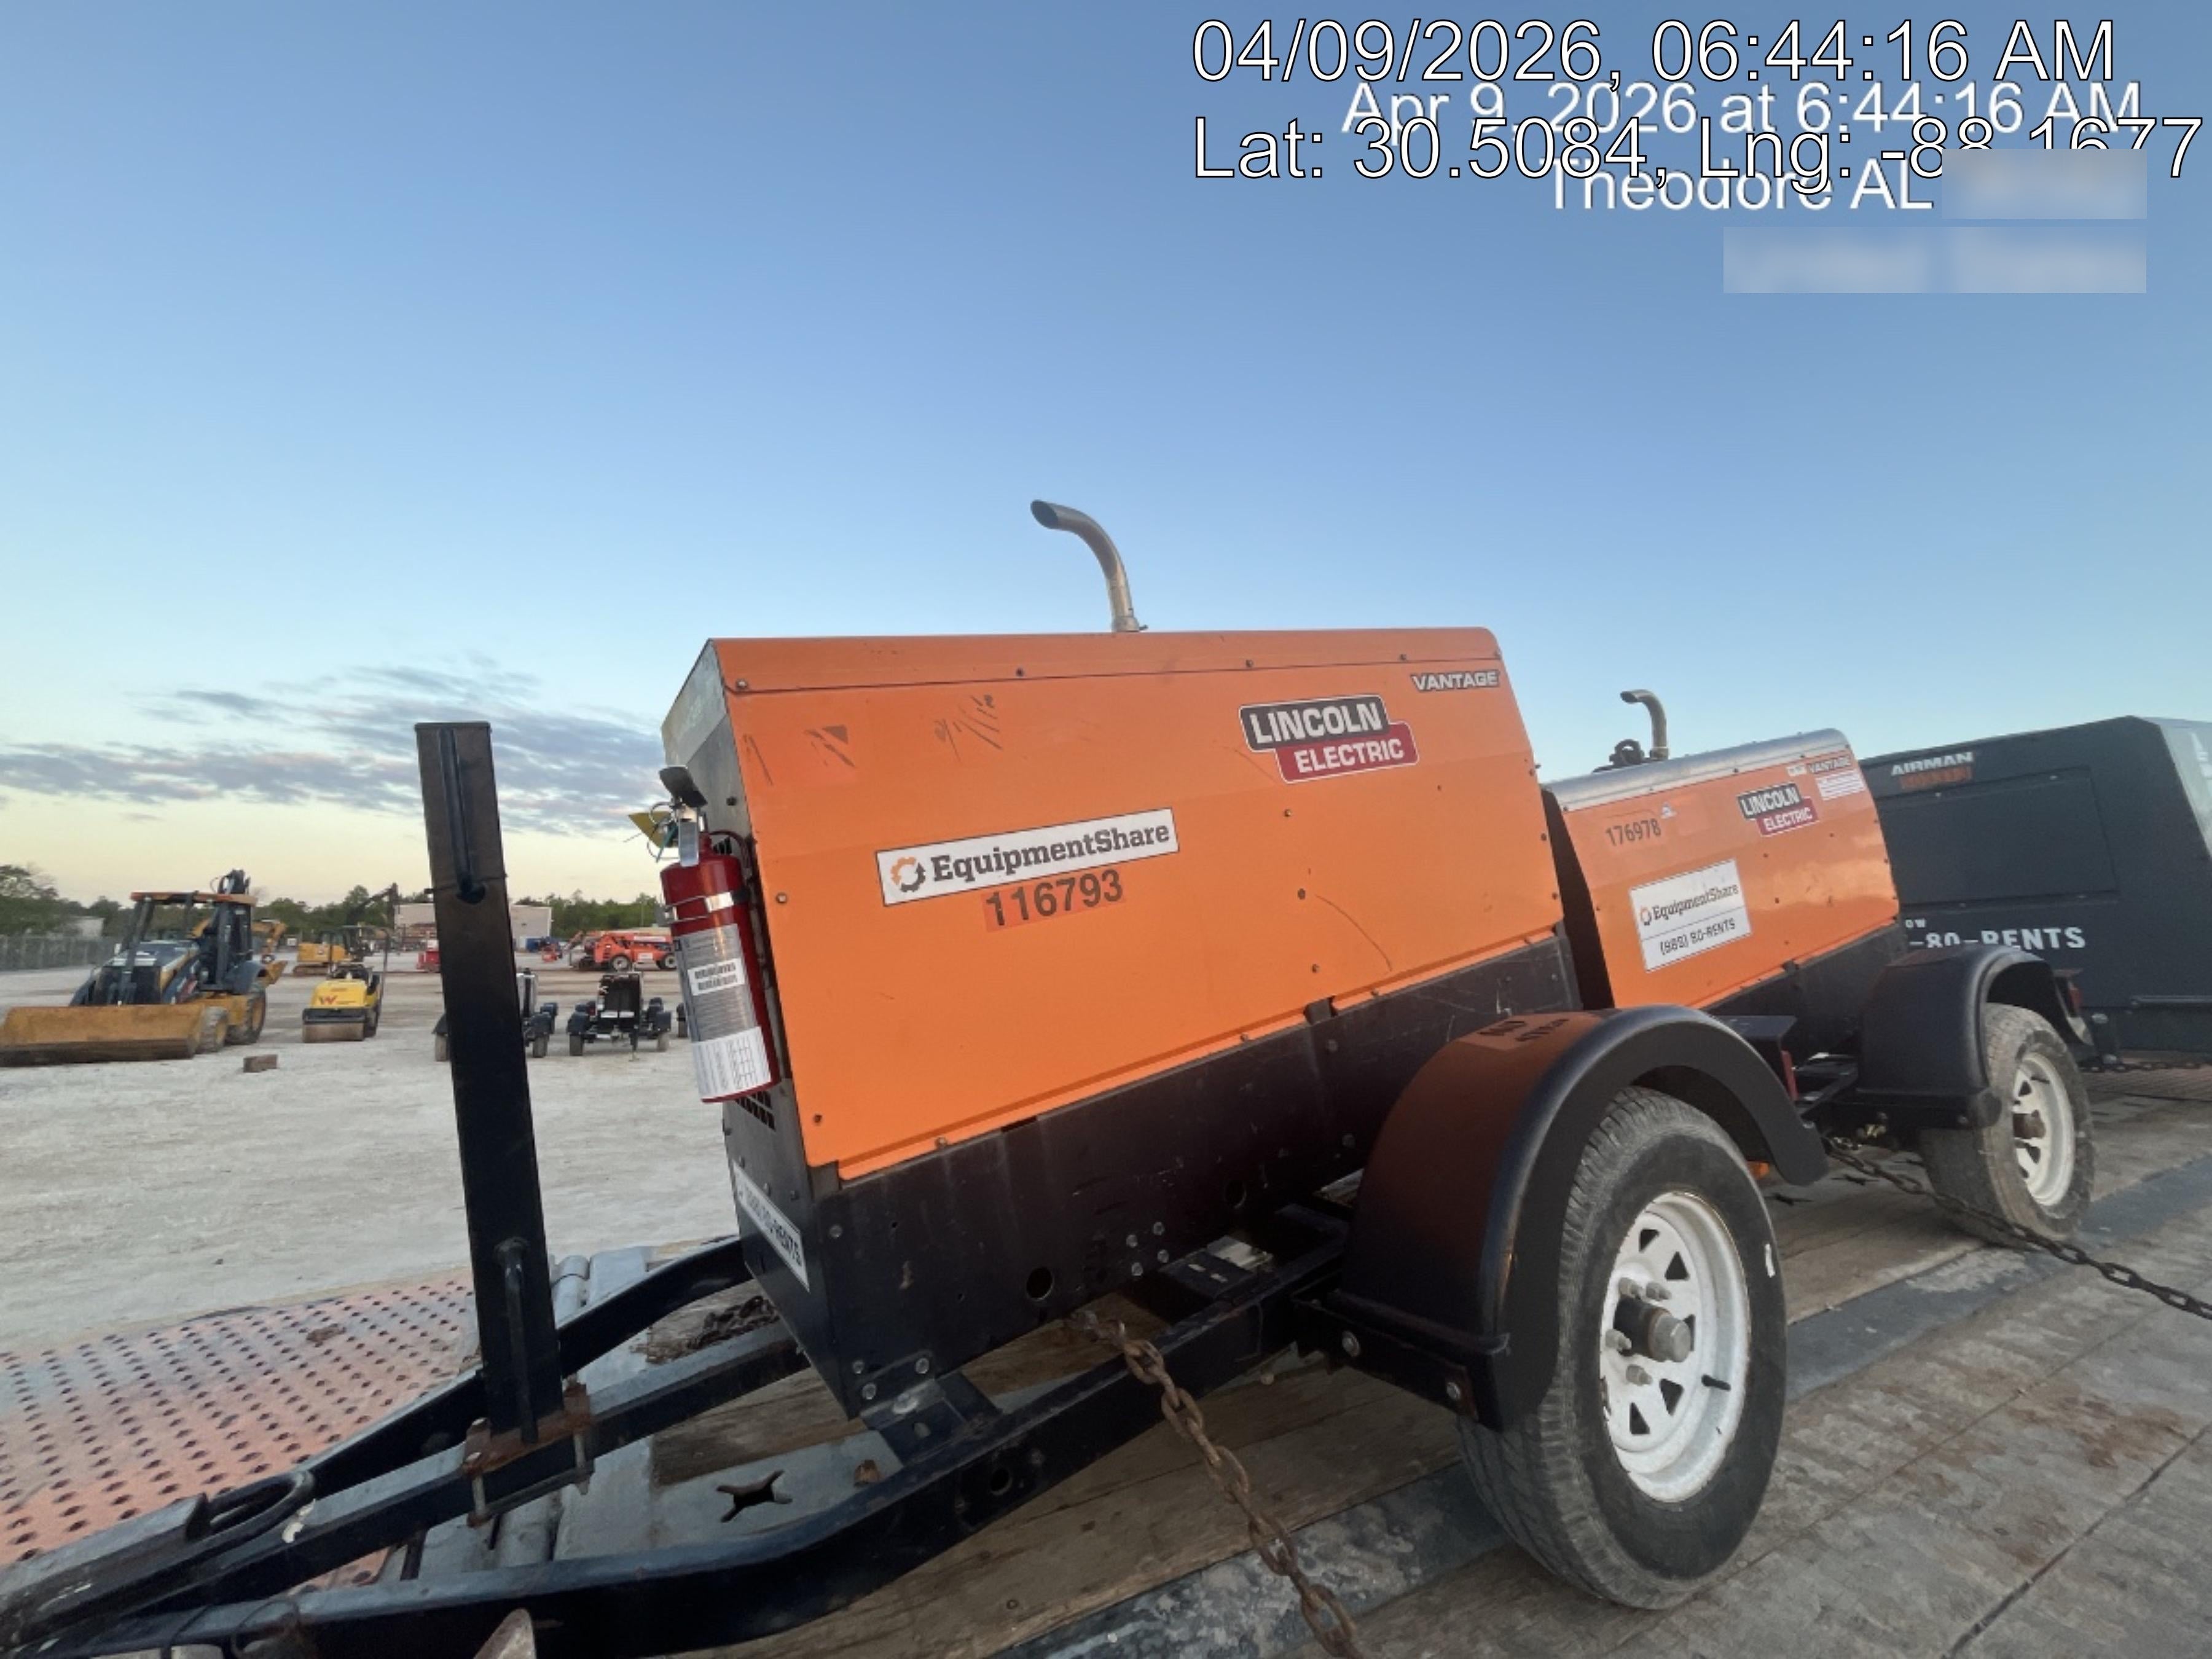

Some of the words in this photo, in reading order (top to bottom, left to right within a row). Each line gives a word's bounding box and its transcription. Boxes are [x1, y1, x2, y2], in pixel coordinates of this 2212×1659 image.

[1413, 670, 1499, 691] VANTAGE
[1249, 702, 1383, 744] LINCOLN
[1294, 738, 1405, 774] ELECTRIC
[1891, 751, 1974, 777] AIRMAN
[1741, 786, 1800, 816] LINCOLN
[1605, 818, 1662, 847] 176978
[1763, 807, 1813, 832] ELECTRIC
[930, 823, 1170, 883] EquipmentShare
[986, 869, 1124, 926] 116793
[1652, 884, 1739, 921] EquipmentShare
